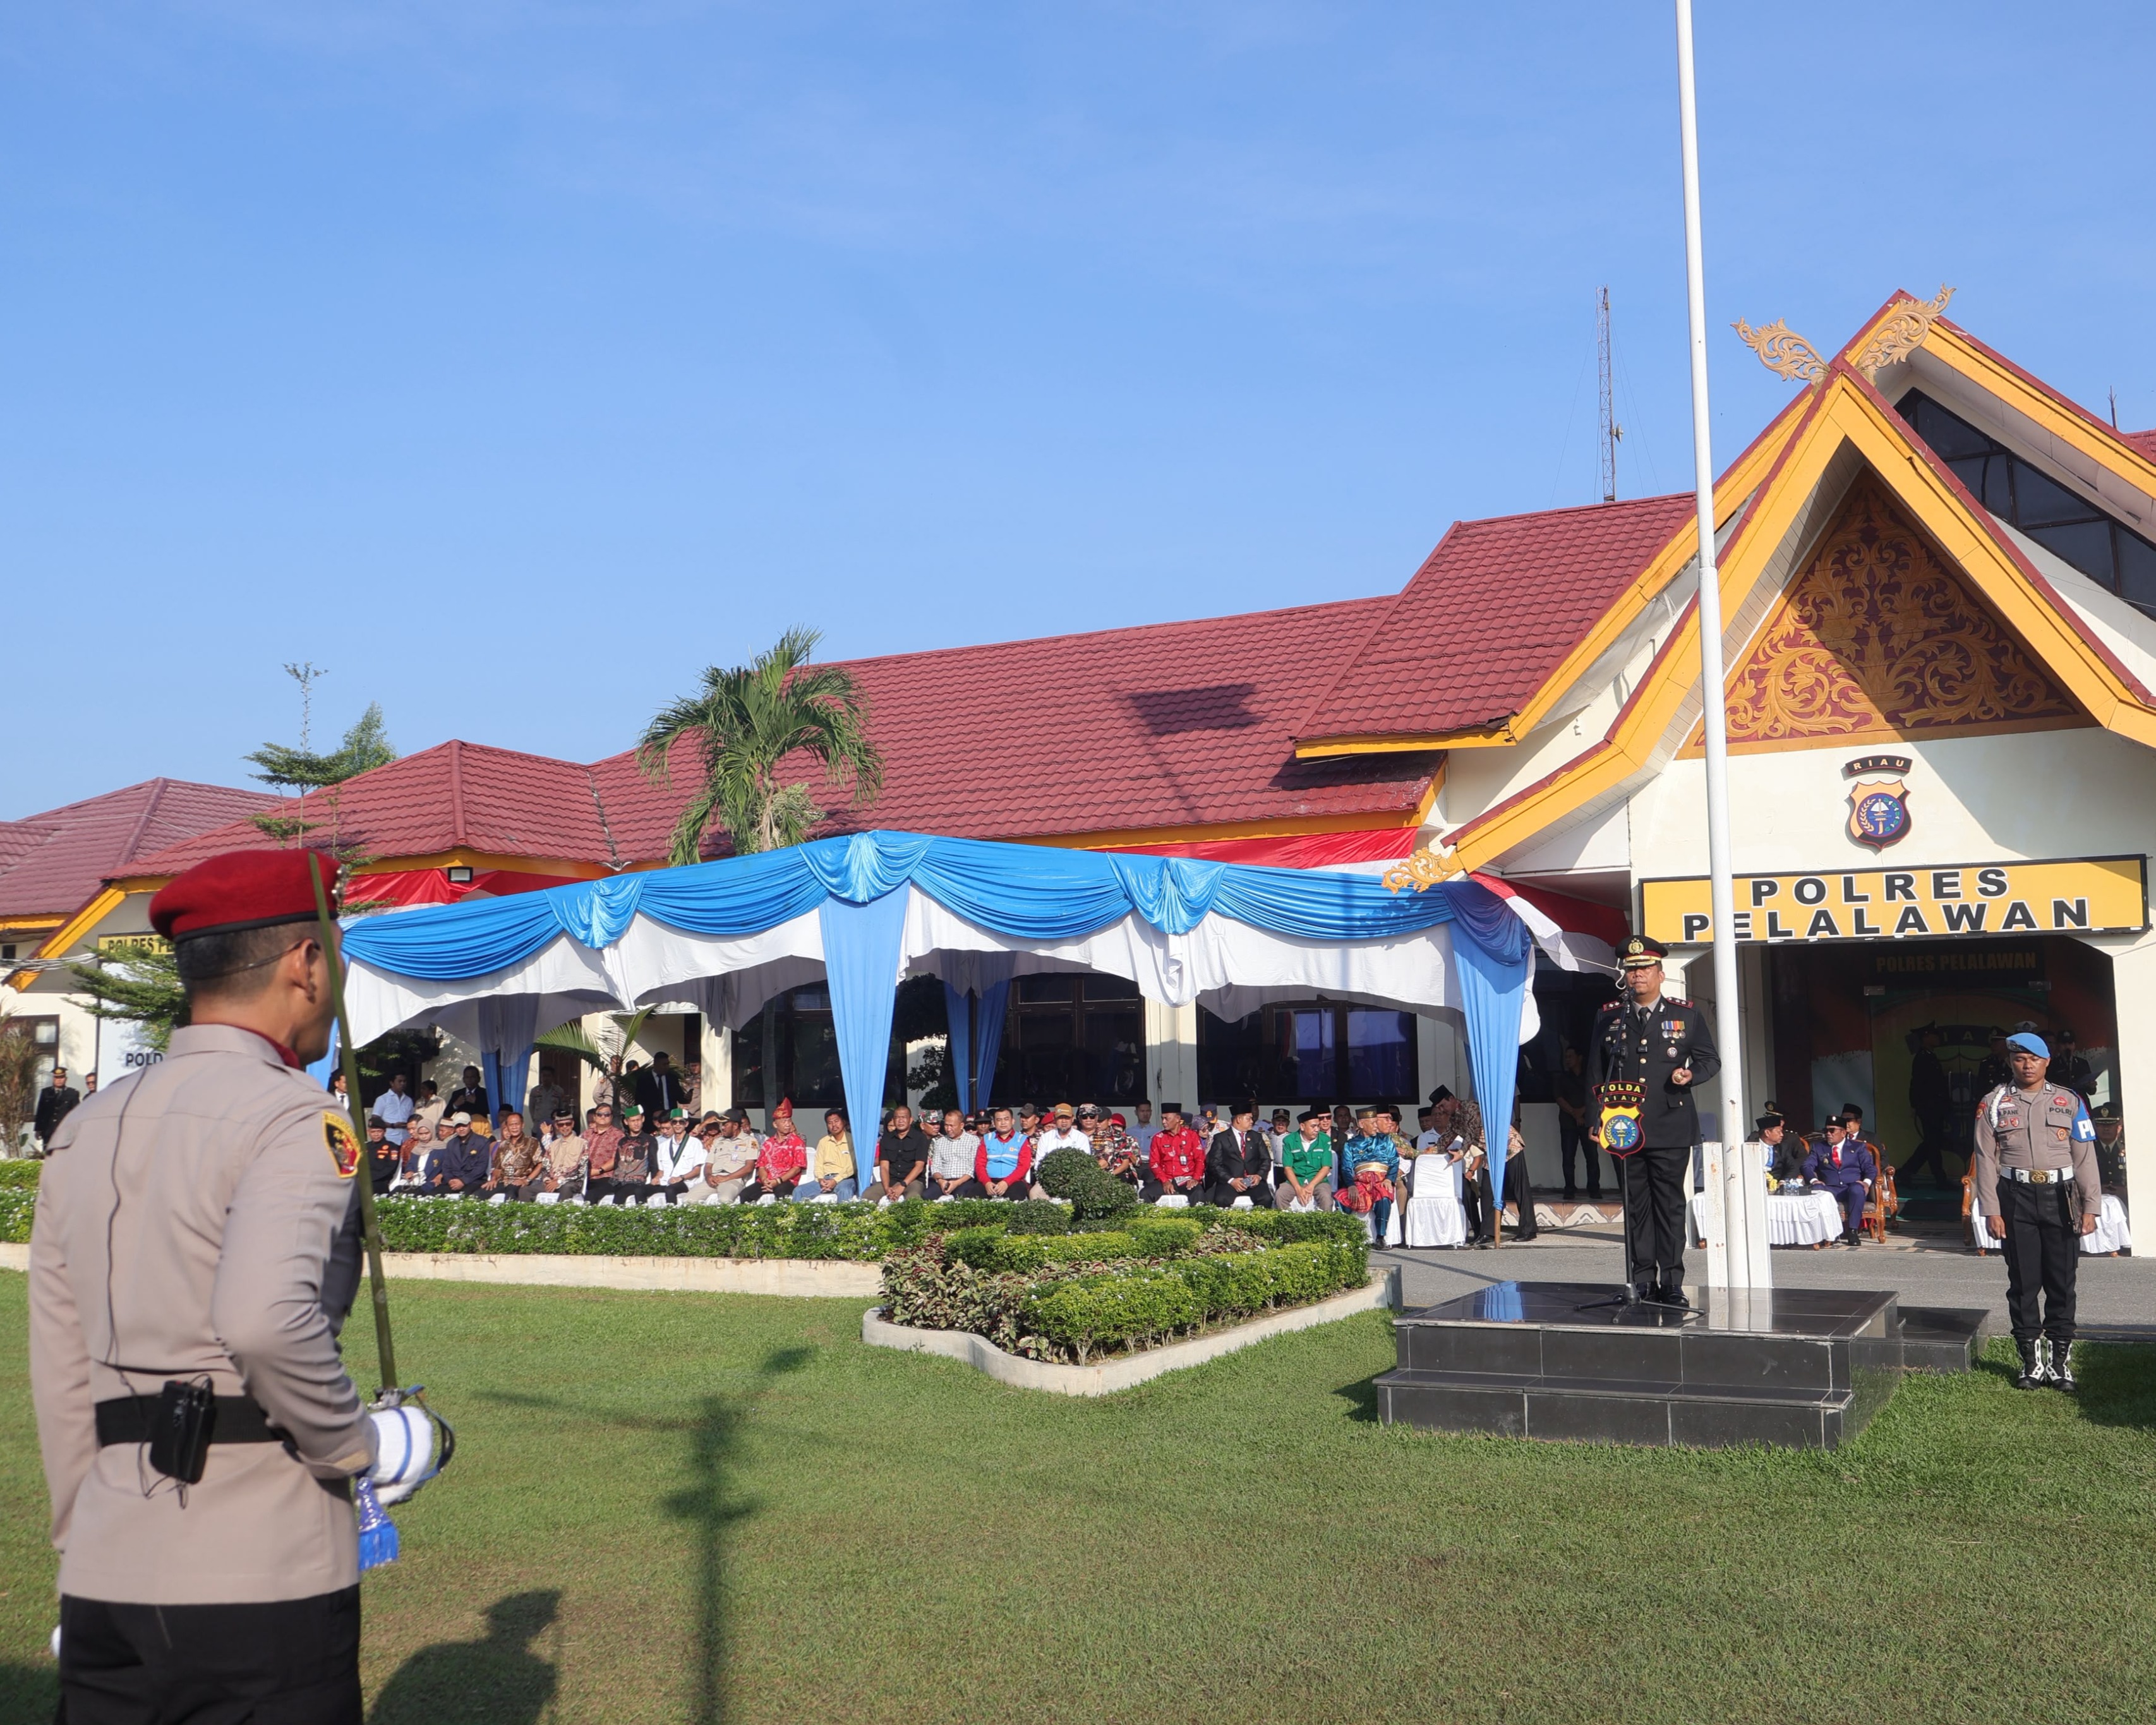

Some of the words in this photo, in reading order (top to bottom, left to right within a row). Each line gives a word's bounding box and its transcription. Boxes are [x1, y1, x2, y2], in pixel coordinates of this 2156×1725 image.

[1853, 758, 1905, 770] RIAU
[1751, 867, 2008, 907] POLRES
[1683, 898, 2088, 941] PELALAWAN
[1876, 954, 1936, 973] POLRES
[1940, 951, 2037, 970] PELALAWAN
[2049, 1107, 2072, 1115] POLRI
